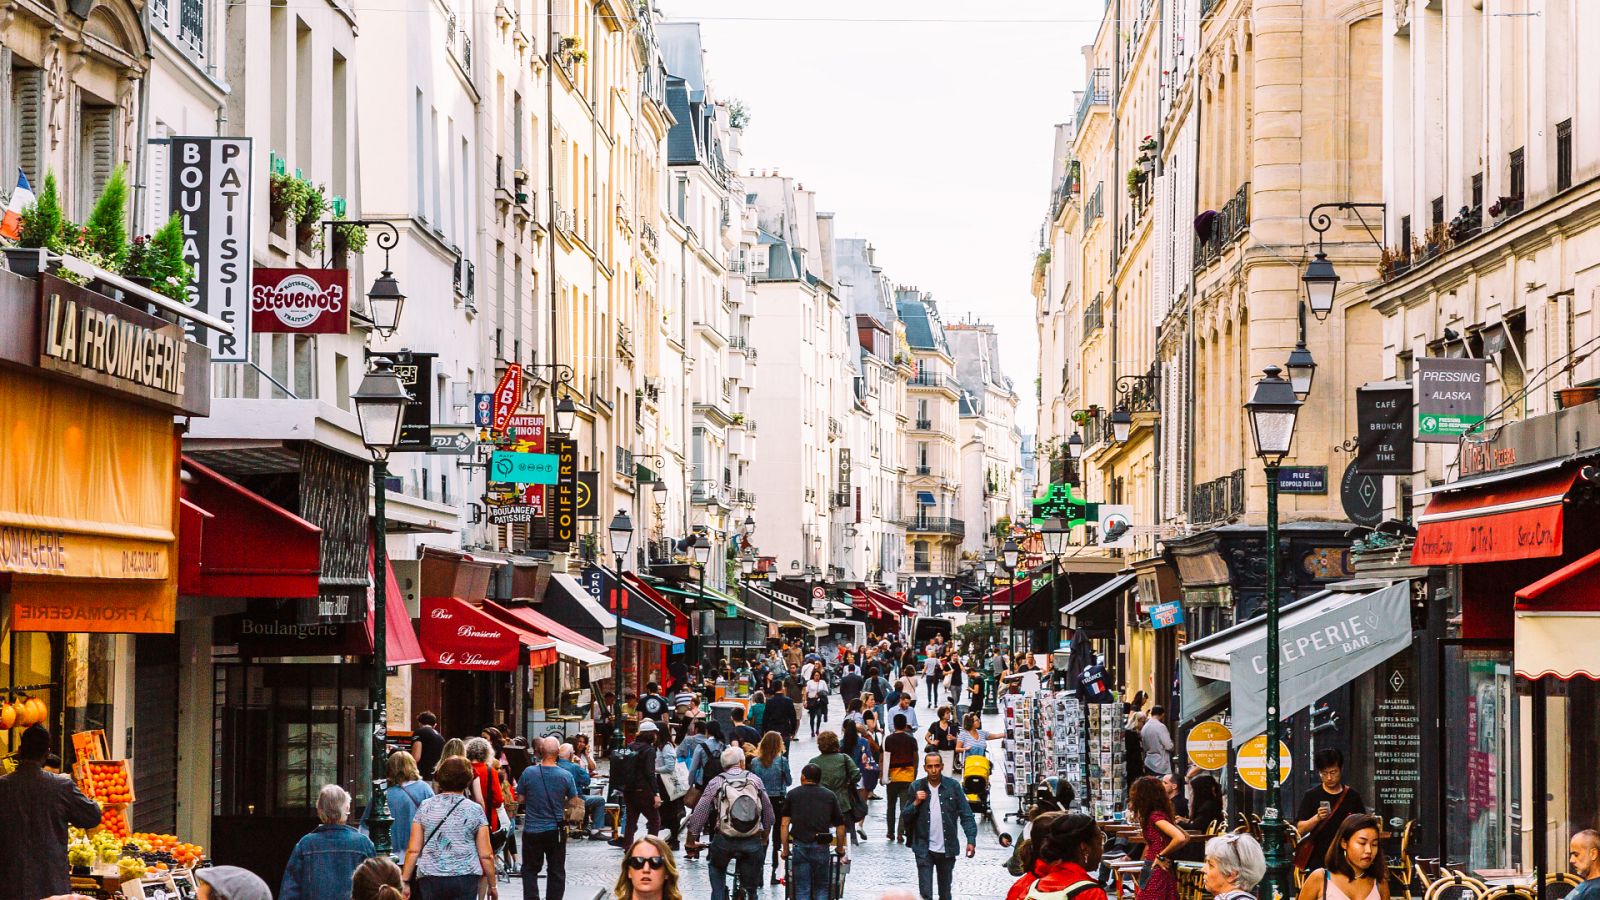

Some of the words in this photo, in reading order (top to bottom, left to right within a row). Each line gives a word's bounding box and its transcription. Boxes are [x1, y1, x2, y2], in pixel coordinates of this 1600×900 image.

[219, 143, 242, 356] PATISSIER
[284, 313, 314, 322] TRAITEUR
[47, 293, 77, 363] LA
[82, 307, 187, 395] FROMAGERIE
[1423, 371, 1481, 383] PRESSING
[497, 370, 517, 425] TABAC
[1432, 391, 1472, 401] ALASKA
[1375, 400, 1396, 408] CAFÉ
[507, 417, 544, 427] RAITEUR
[1370, 422, 1403, 430] BRUNCH
[432, 435, 452, 446] FDJ
[1378, 444, 1394, 452] TEA
[1376, 453, 1395, 461] TIME
[1303, 480, 1323, 488] BELLAN
[559, 442, 573, 541] COIFFIRST
[493, 506, 536, 516] BOULANGER
[494, 514, 532, 524] PATISSIER
[0, 527, 65, 569] OMAGERIE
[1029, 559, 1043, 567] BAR
[431, 608, 453, 619] Bar
[242, 619, 337, 640] Boulangerie
[456, 625, 502, 638] Brasserie
[1252, 615, 1365, 675] CÊPERIE
[1342, 635, 1370, 653] BAR
[438, 651, 456, 665] Le
[459, 652, 501, 666] Havane
